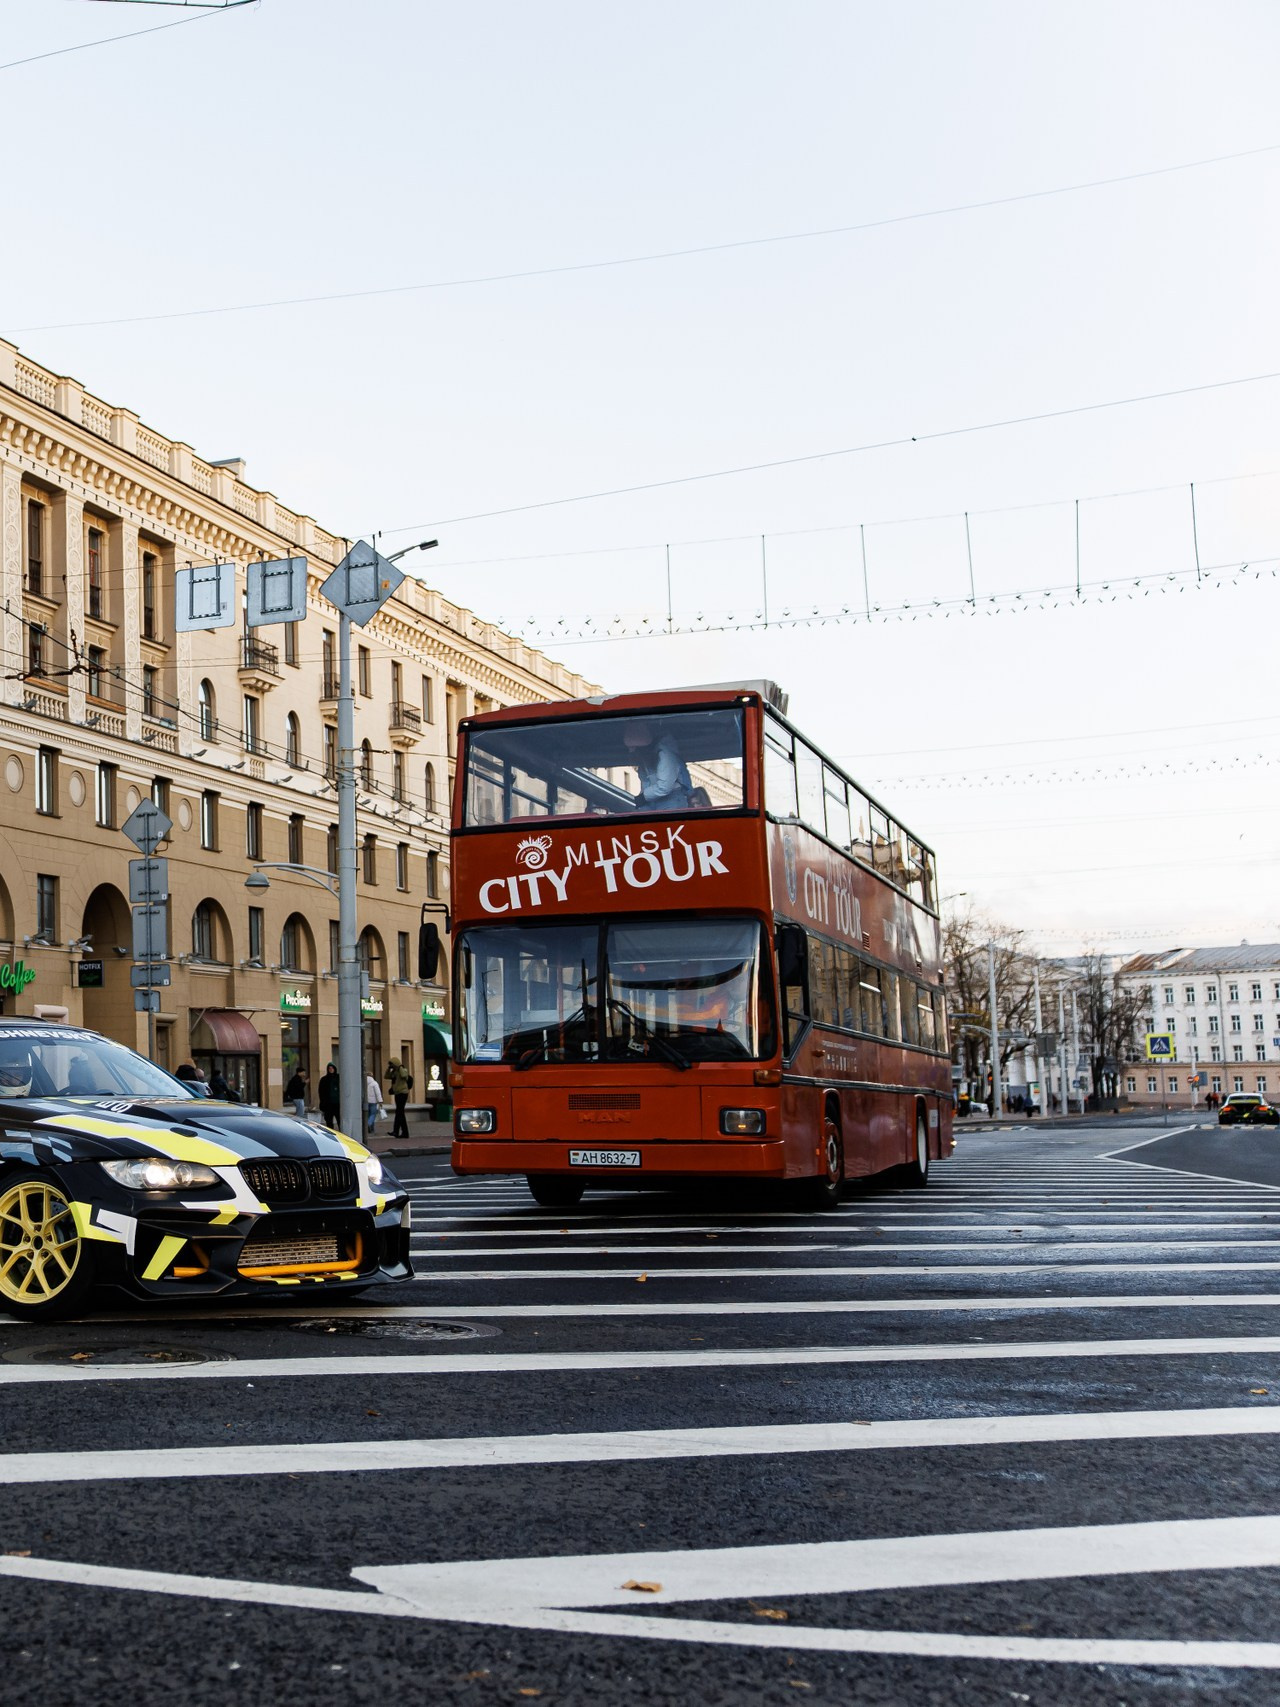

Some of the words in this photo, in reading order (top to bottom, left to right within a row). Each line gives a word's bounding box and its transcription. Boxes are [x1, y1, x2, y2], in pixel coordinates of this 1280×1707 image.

[565, 825, 687, 866] MINSK
[478, 865, 572, 913] CITY
[594, 840, 730, 893] TOUR
[804, 867, 829, 925] CITY
[833, 885, 863, 942] TOUR
[0, 960, 37, 994] Coffee
[578, 1112, 631, 1124] MAN
[581, 1152, 598, 1164] AH
[599, 1153, 638, 1165] 8632-7
